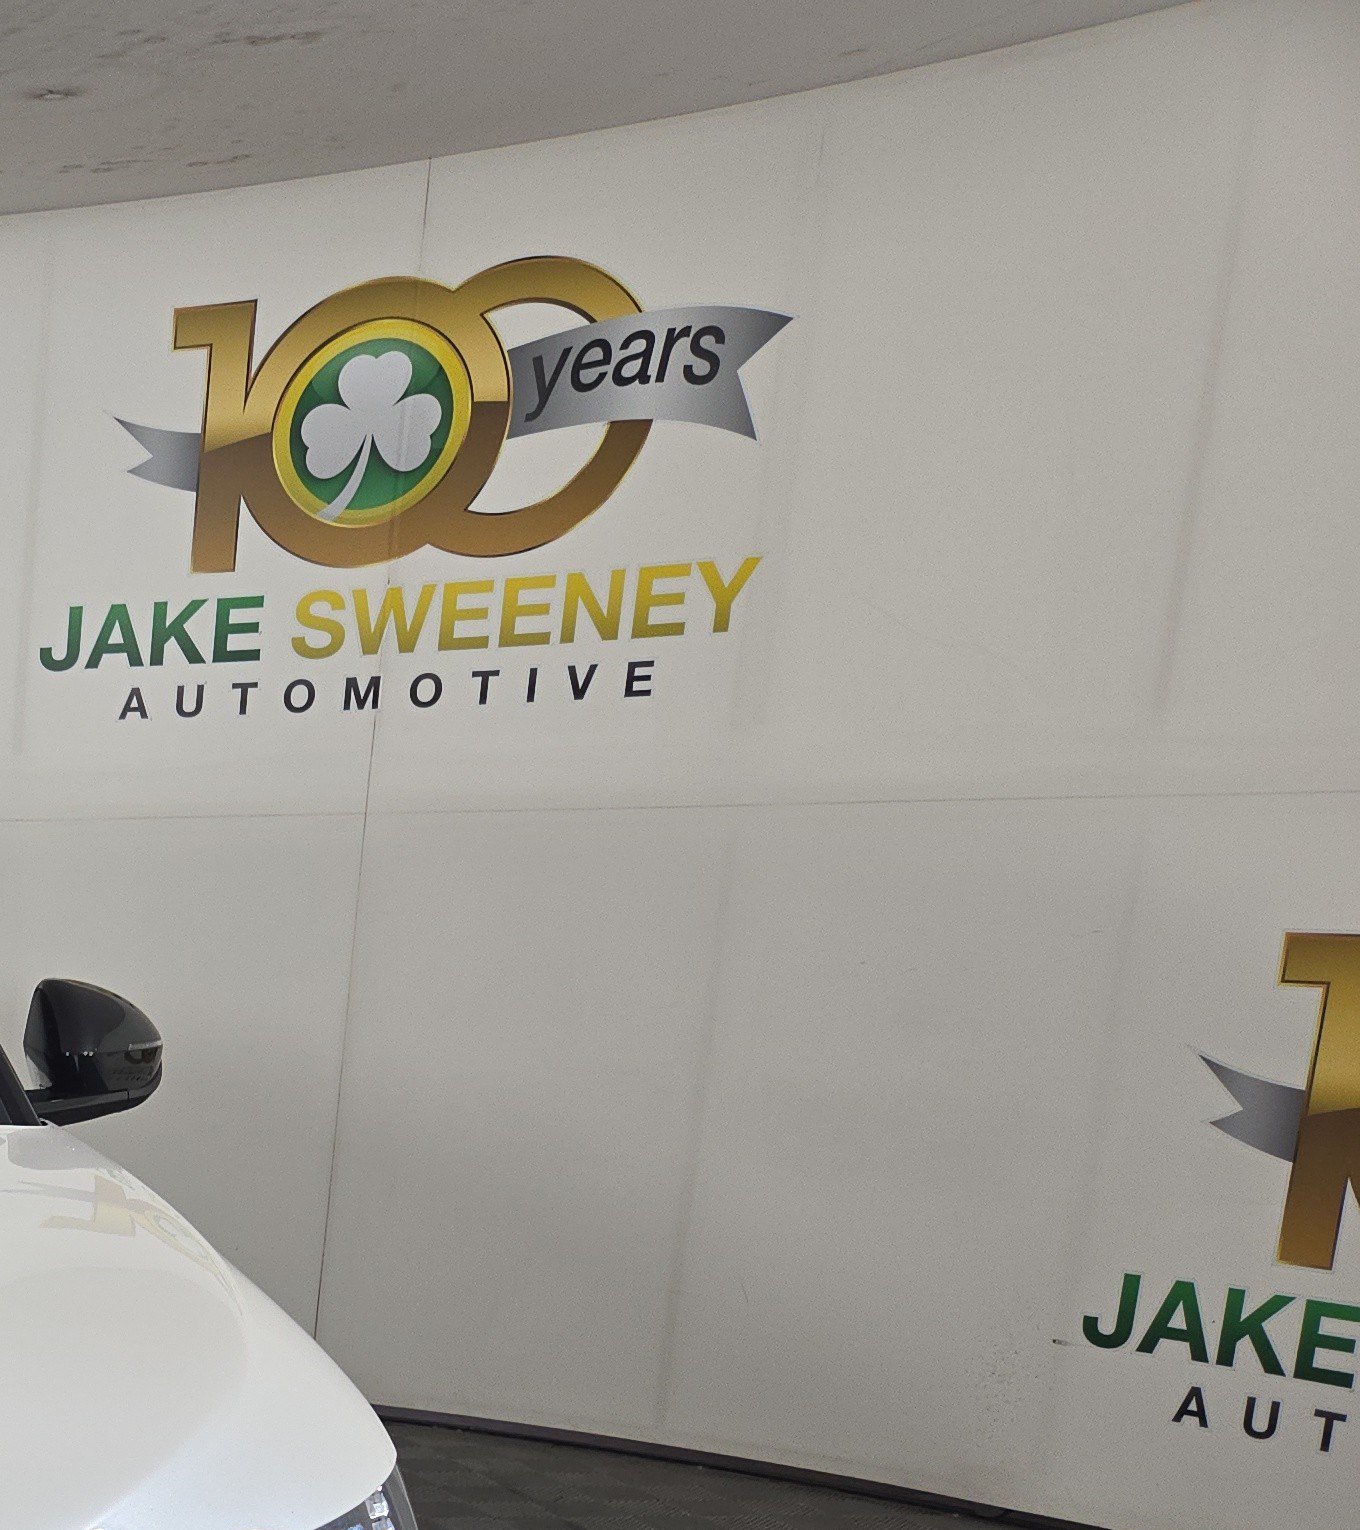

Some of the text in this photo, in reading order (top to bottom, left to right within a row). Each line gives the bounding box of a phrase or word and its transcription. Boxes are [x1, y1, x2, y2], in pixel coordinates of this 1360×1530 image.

[524, 323, 726, 423] years
[39, 556, 762, 673] JAKE SWEENEY
[118, 660, 656, 721] AUTOMOTIVE
[1082, 1272, 1360, 1390] JAKE
